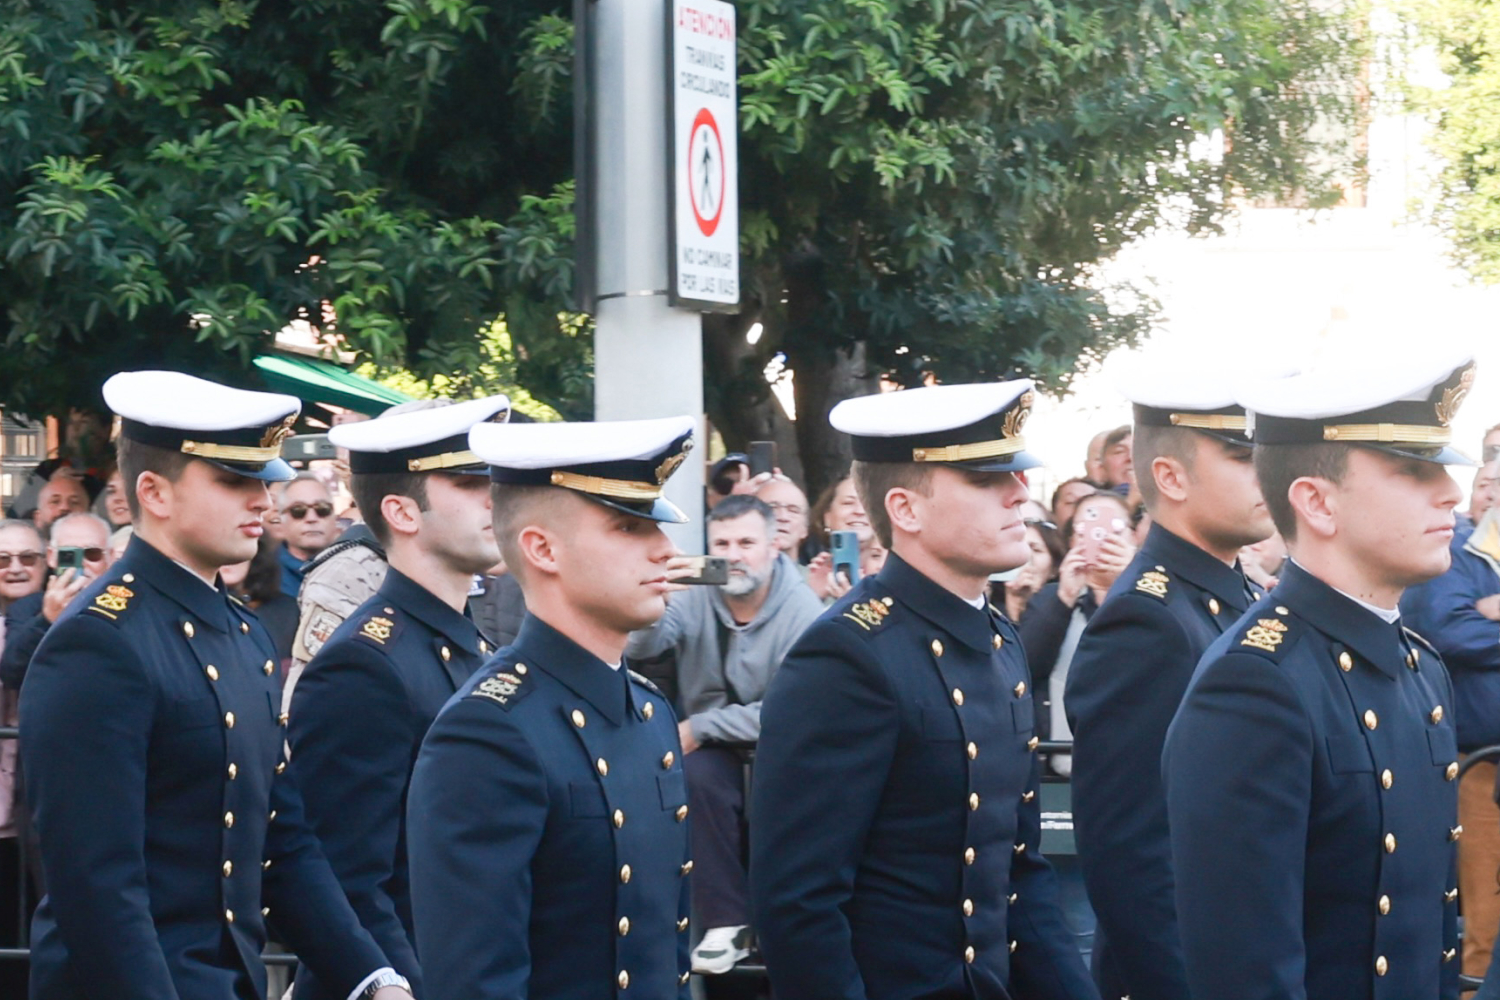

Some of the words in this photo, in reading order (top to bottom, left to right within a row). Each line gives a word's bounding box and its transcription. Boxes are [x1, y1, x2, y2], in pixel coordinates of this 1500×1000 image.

[680, 71, 730, 98] CIRCULANDO
[683, 246, 694, 264] NO
[697, 249, 732, 270] CAMINAR
[681, 273, 696, 291] POR
[700, 276, 715, 293] LAS
